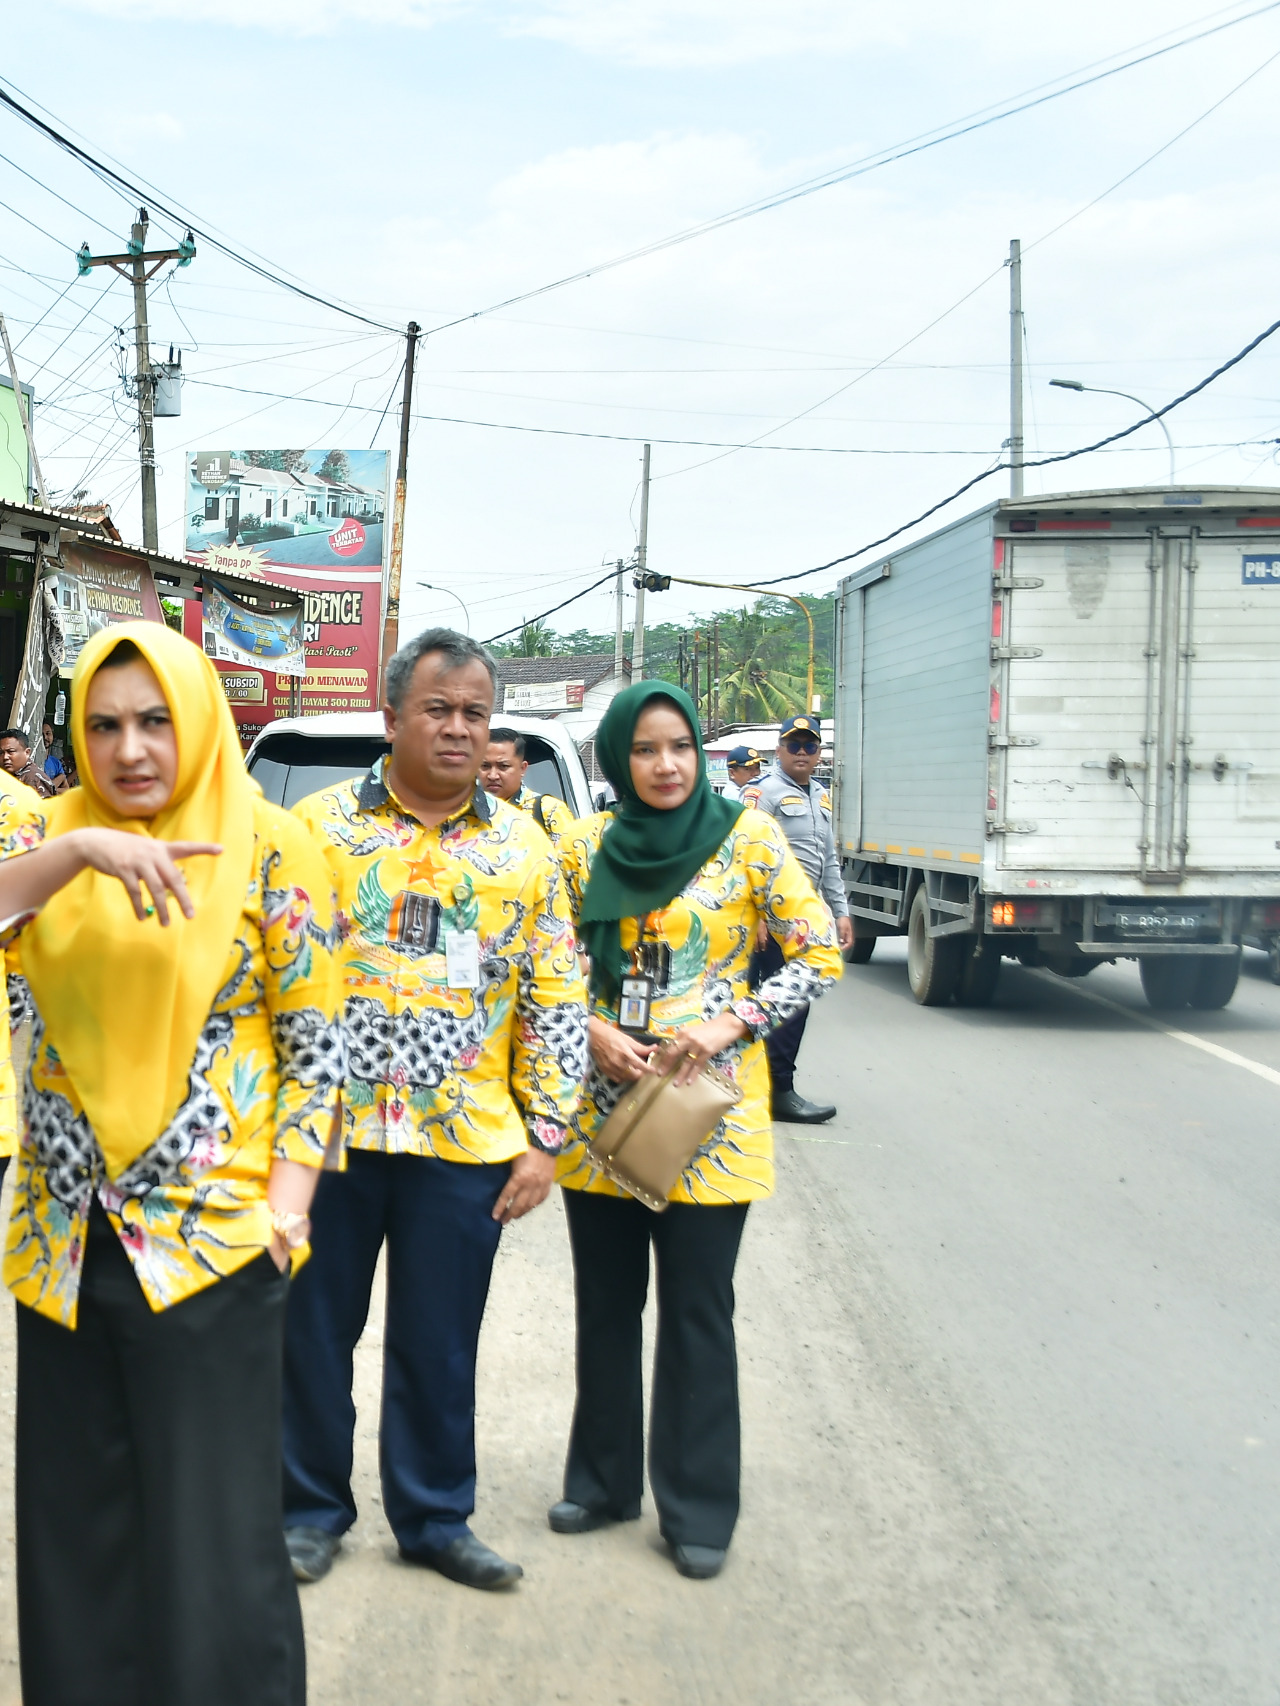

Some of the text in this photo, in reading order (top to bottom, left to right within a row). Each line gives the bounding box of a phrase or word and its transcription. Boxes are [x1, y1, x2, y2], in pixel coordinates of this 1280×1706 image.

[334, 528, 358, 543] UNIT
[214, 554, 252, 569] Tanpa DP
[225, 678, 258, 688] SUBSIDI
[278, 675, 368, 686] PRMO MENAWAN
[302, 697, 329, 706] BAYAR
[331, 698, 348, 706] 500
[350, 699, 371, 707] RIBU
